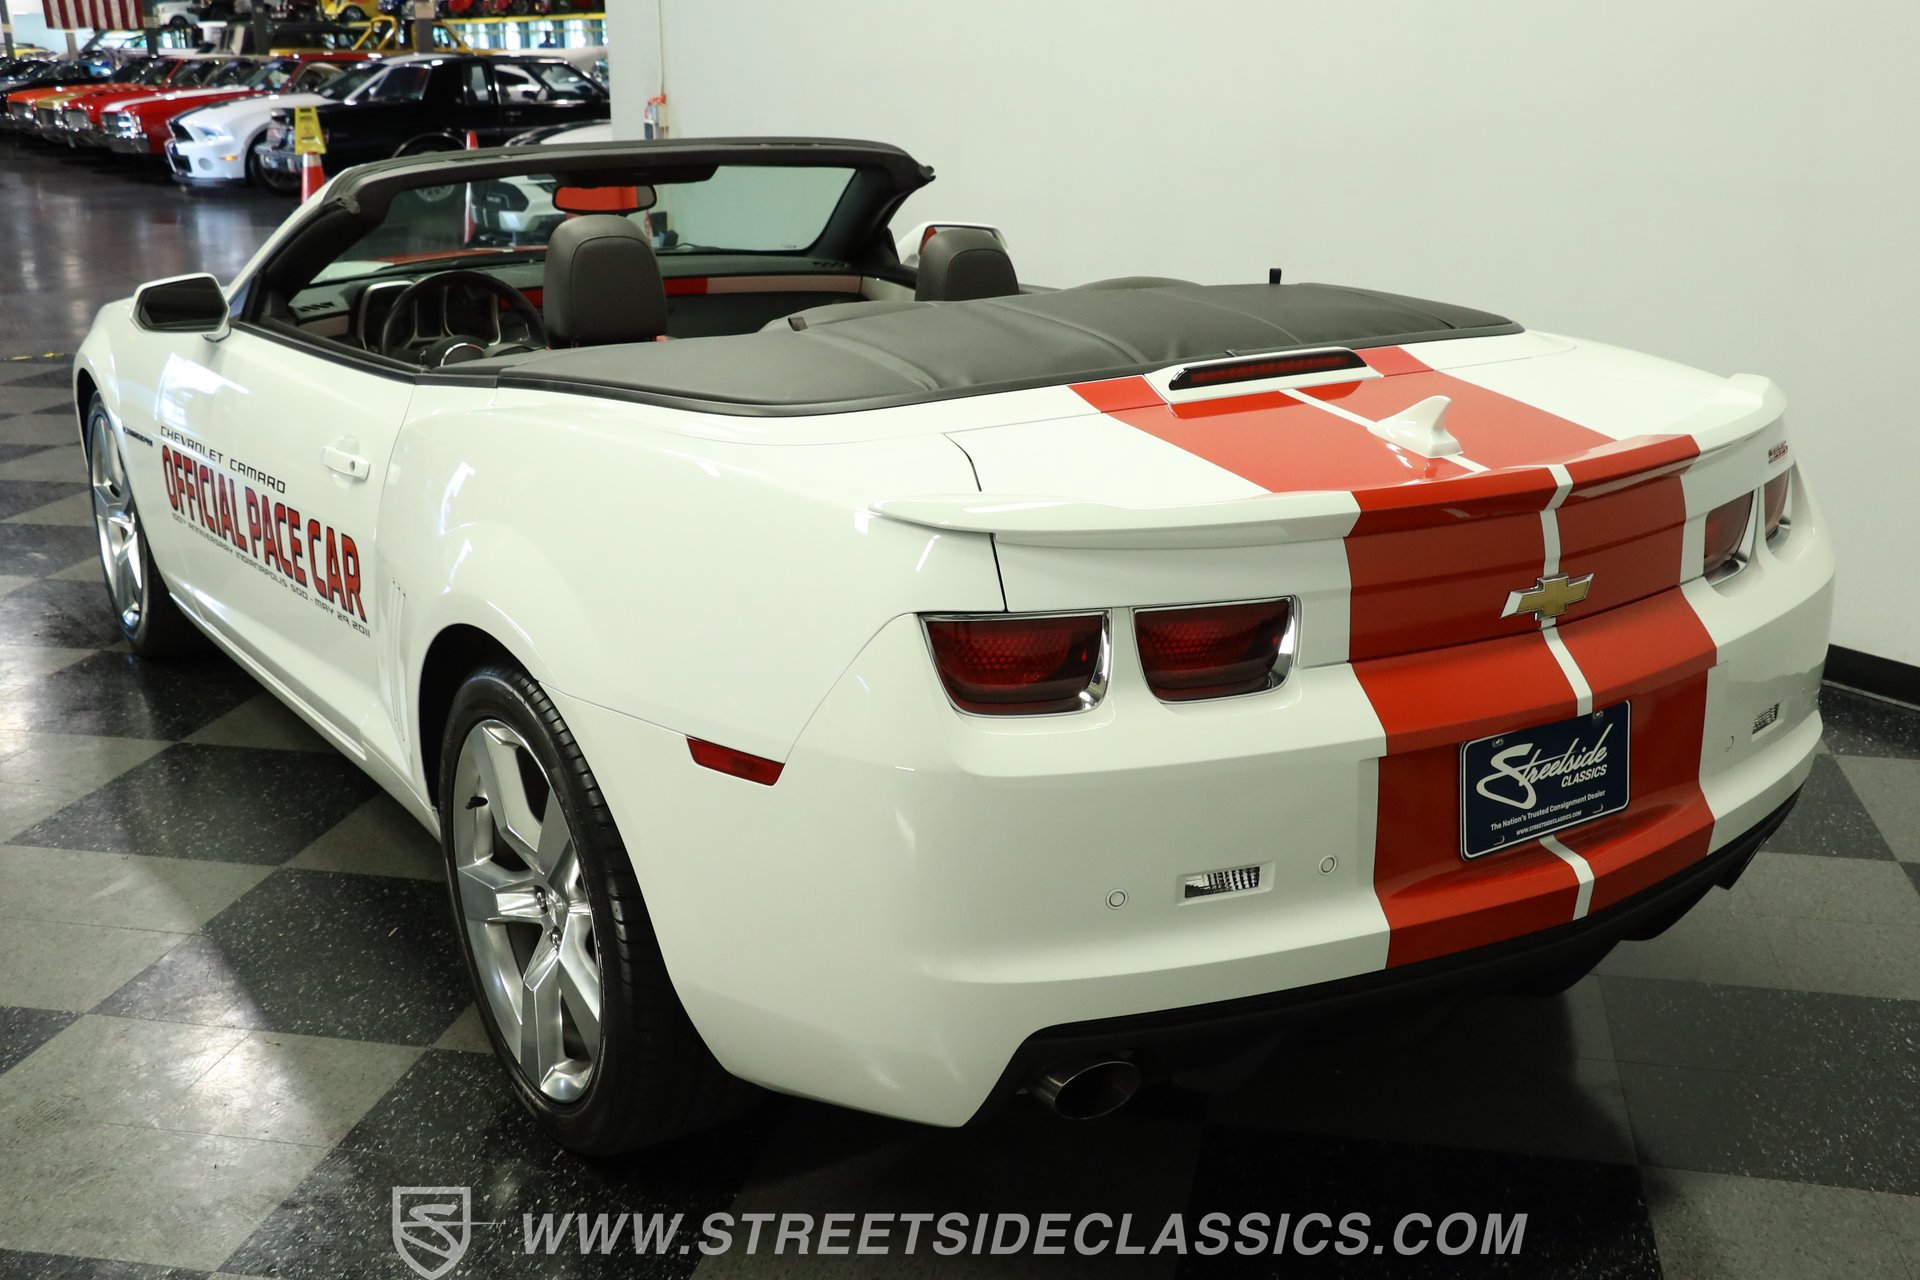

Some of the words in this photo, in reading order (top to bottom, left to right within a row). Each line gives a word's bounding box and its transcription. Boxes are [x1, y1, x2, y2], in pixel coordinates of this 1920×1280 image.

[160, 426, 224, 465] CHEVROLET
[229, 459, 286, 494] CAMARO
[162, 445, 248, 552] OFFICIAL
[245, 486, 308, 588] PACE
[307, 518, 368, 624] CAR
[188, 522, 233, 553] ANNIVERSARY
[235, 550, 288, 588] INDIANAPOLIS
[290, 582, 309, 601] 500
[314, 598, 334, 616] MAY
[351, 620, 371, 639] 2011
[1476, 723, 1614, 810] Streetside
[1561, 763, 1608, 788] CLASSICS
[1490, 822, 1502, 832] The
[1502, 813, 1527, 830] Nation's
[1527, 806, 1549, 820] Trusted
[1549, 796, 1587, 812] Consignment
[1587, 789, 1606, 802] Dealer
